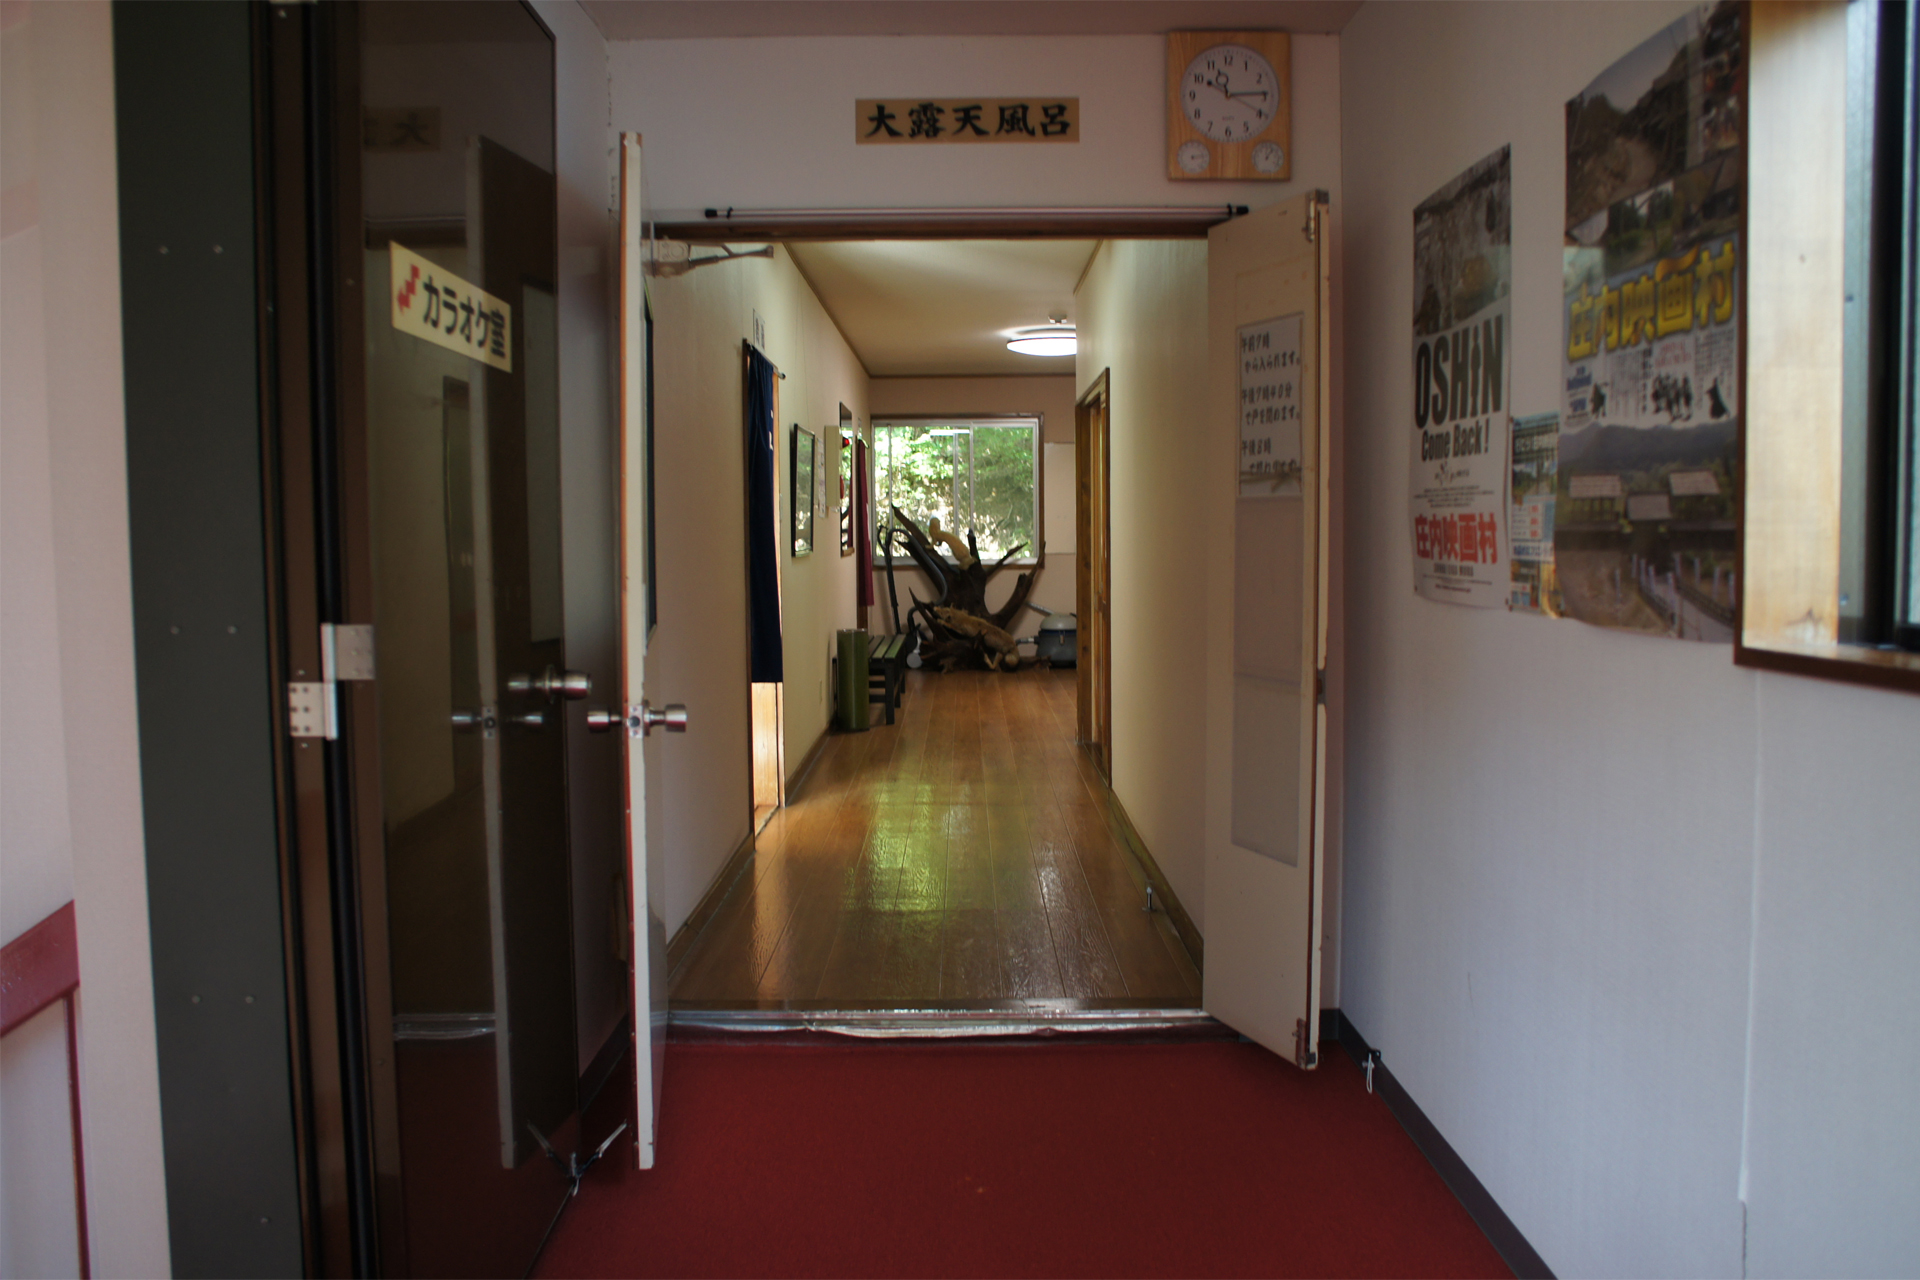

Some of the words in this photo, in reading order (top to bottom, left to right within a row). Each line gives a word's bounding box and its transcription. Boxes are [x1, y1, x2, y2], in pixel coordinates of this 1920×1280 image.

[1207, 59, 1215, 71] 11
[1224, 54, 1234, 66] 12
[1194, 72, 1204, 84] 10
[1256, 73, 1262, 84] 2
[1189, 89, 1196, 102] 9
[1194, 107, 1201, 120] 8
[865, 102, 1071, 138] 大露天風呂
[1208, 120, 1214, 132] 7
[1225, 125, 1231, 137] 6
[1243, 121, 1249, 133] 5
[1568, 240, 1735, 363] 庄内映画村
[1422, 430, 1450, 462] Come
[1415, 512, 1497, 564] 庄内映画村
